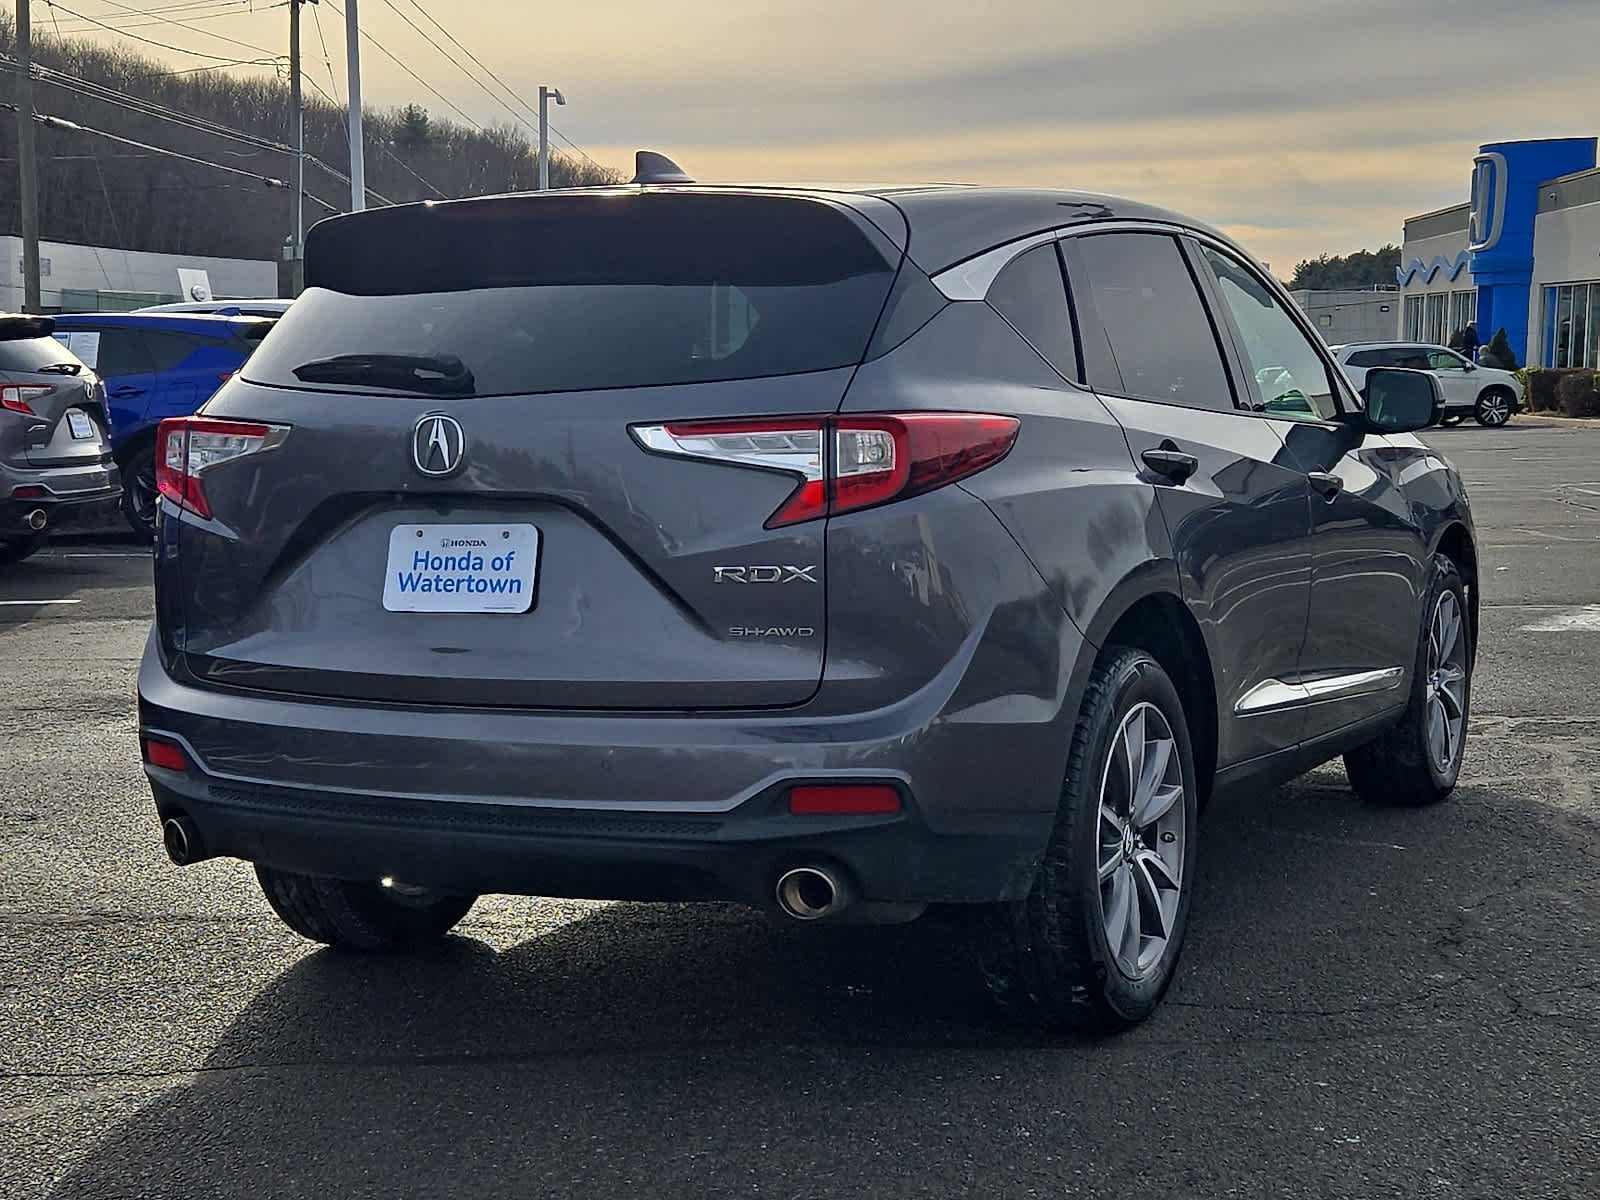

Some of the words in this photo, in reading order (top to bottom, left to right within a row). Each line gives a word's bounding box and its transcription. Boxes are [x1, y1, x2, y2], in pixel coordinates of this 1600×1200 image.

[450, 539, 487, 547] HONDA
[413, 550, 484, 571] Honda
[490, 550, 516, 571] of
[398, 572, 522, 594] Watertown
[712, 565, 817, 583] RDX
